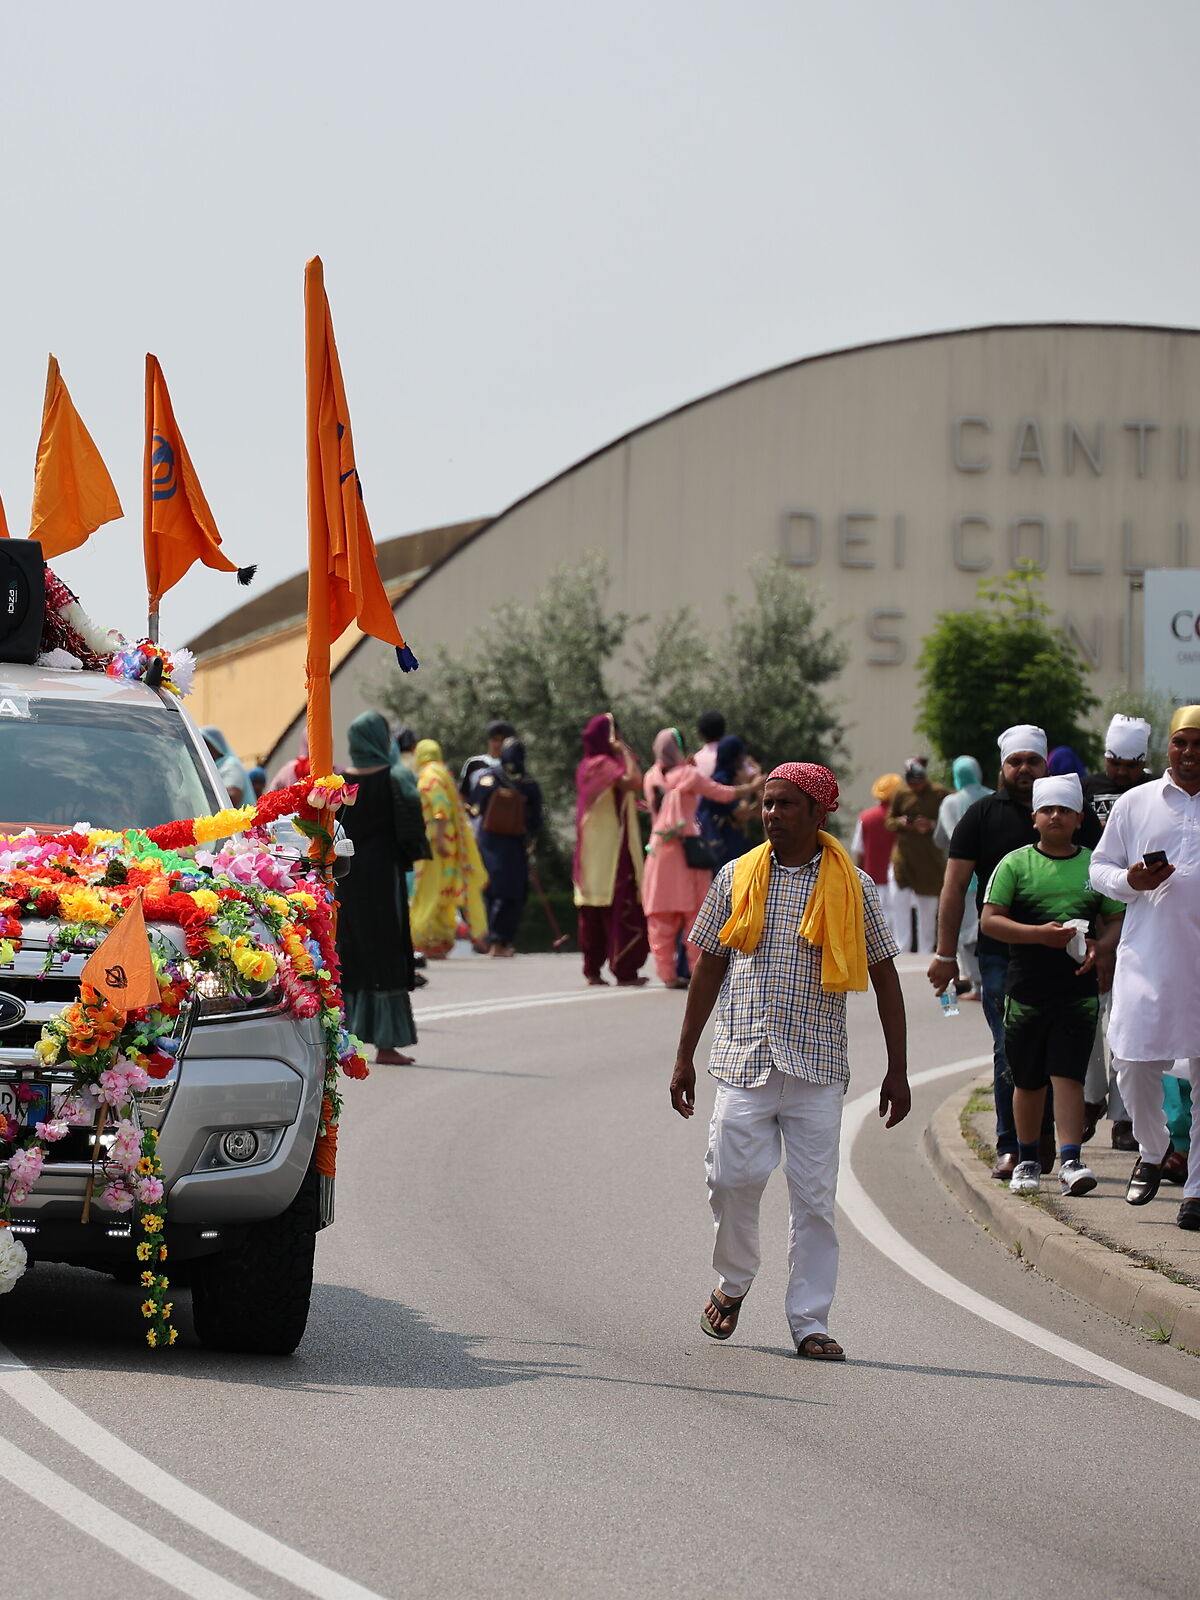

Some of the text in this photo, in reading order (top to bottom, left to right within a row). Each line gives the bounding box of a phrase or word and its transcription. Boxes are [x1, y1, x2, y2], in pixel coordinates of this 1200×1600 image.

[953, 416, 1200, 477] CANTI
[784, 509, 1190, 575] DEI COLLI
[7, 589, 15, 614] ibiza
[1170, 610, 1200, 643] C
